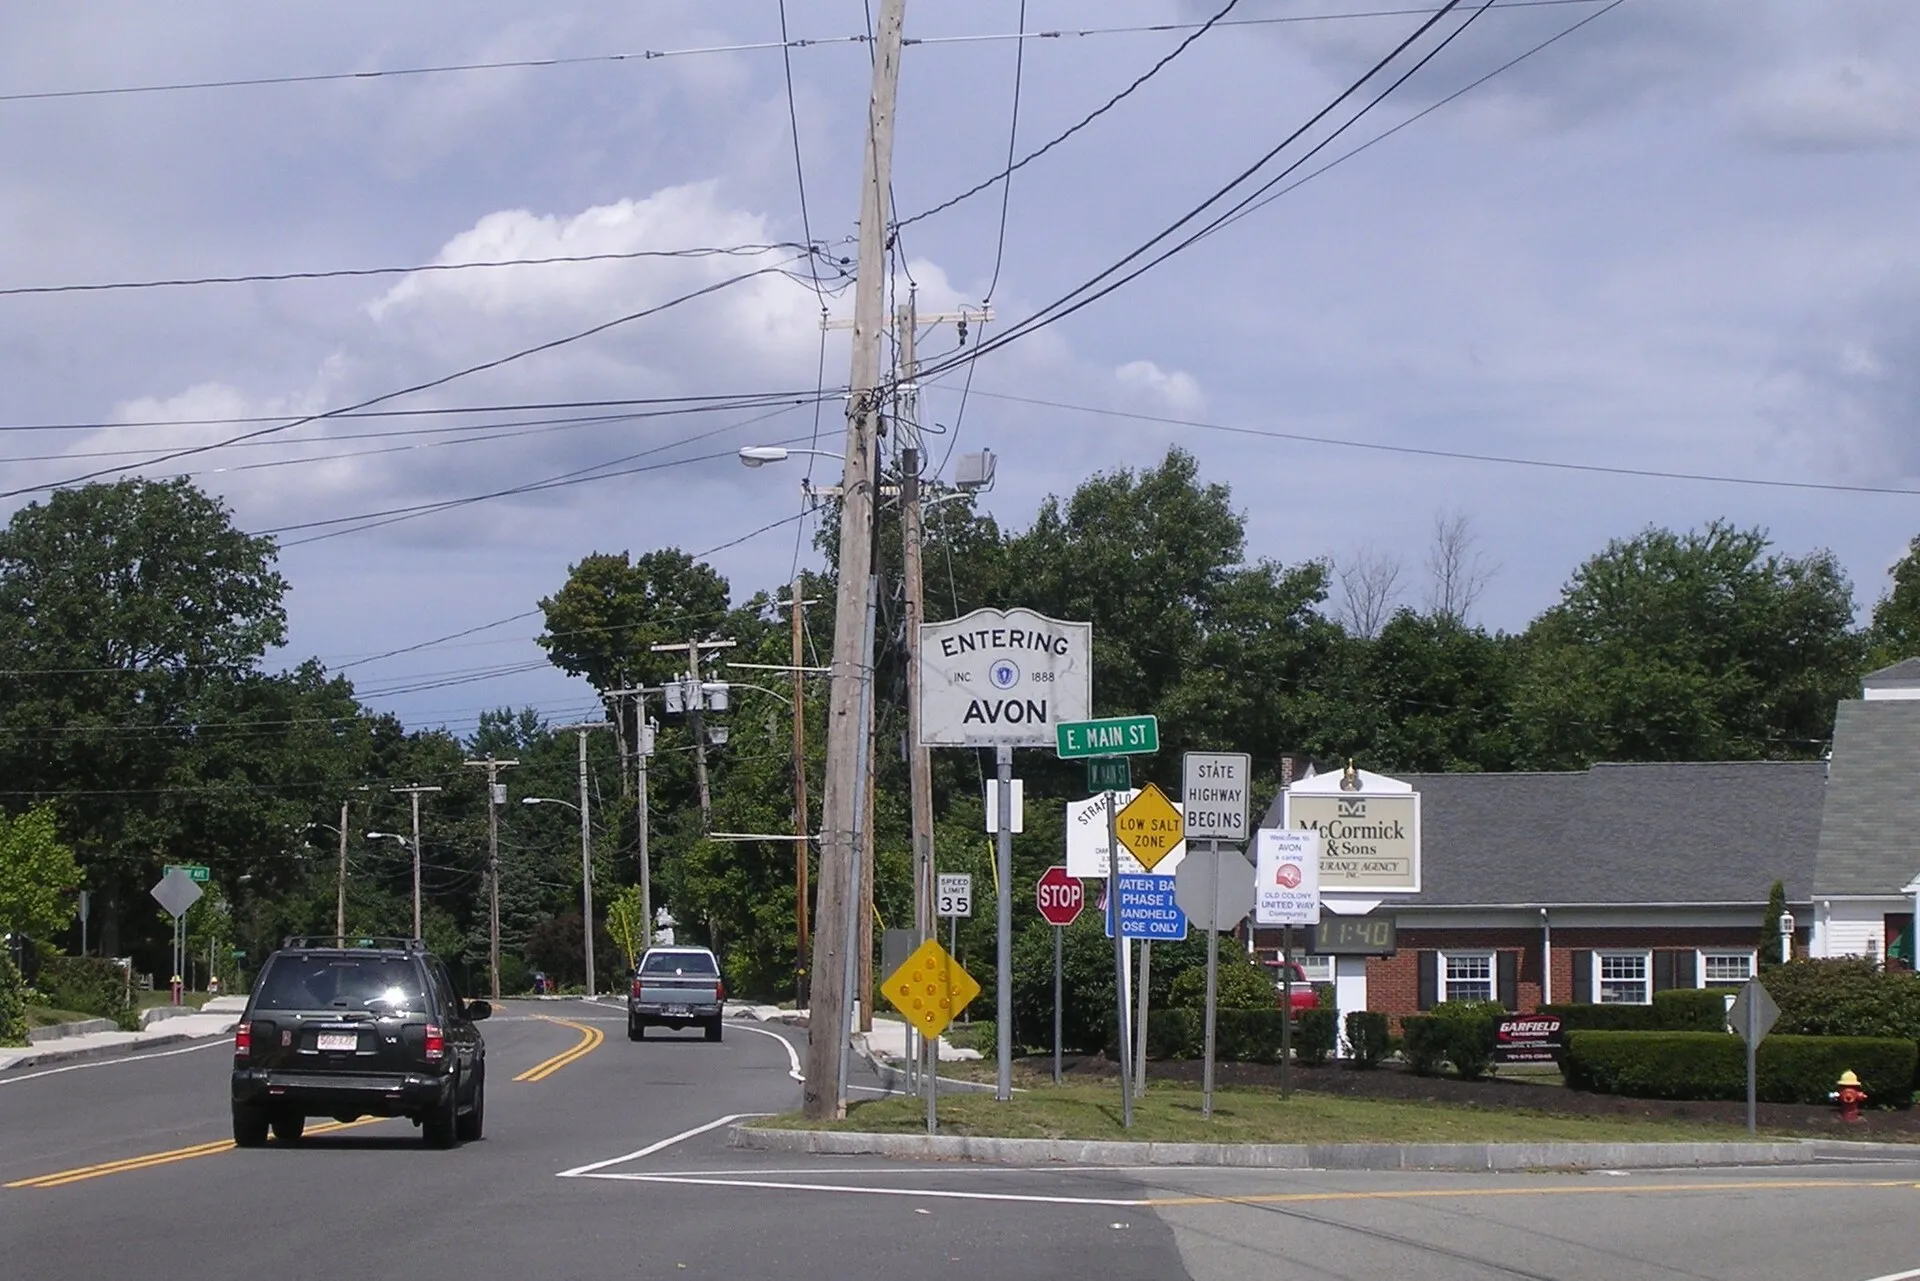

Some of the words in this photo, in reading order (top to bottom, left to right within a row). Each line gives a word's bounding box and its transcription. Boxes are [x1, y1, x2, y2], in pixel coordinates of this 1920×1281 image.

[941, 629, 1068, 657] ENTERING
[1031, 672, 1055, 682] 1888
[963, 699, 1047, 724] AVON
[1067, 729, 1081, 750] E.
[1086, 726, 1123, 748] MAIN
[1129, 724, 1146, 745] ST
[1198, 764, 1235, 779] STATE
[1189, 788, 1242, 802] HIGHWAY
[1077, 793, 1132, 826] STRAFLO
[1120, 818, 1145, 831] LOW
[1151, 819, 1180, 832] SALT
[1188, 811, 1242, 829] BEGINS
[1299, 819, 1405, 840] McCormick
[1134, 835, 1166, 848] ZONE
[1269, 834, 1301, 842] Welcome
[1278, 843, 1302, 852] AVON
[1326, 839, 1339, 856] &
[1342, 841, 1377, 855] Sons
[1319, 861, 1358, 872] URANCE
[1361, 862, 1399, 872] AGENCY
[941, 878, 969, 886] SPEED
[1159, 880, 1176, 892] BA
[1040, 884, 1081, 908] STOP
[1122, 893, 1164, 906] PHASE
[940, 896, 968, 913] 35
[1261, 901, 1294, 909] UNITED
[1296, 901, 1315, 909] WAY
[1268, 910, 1308, 919] Community
[1122, 921, 1146, 932] OSE
[1150, 922, 1179, 933] ONLY
[1321, 922, 1390, 946] 11:40
[1500, 1021, 1561, 1032] GARFIELD
